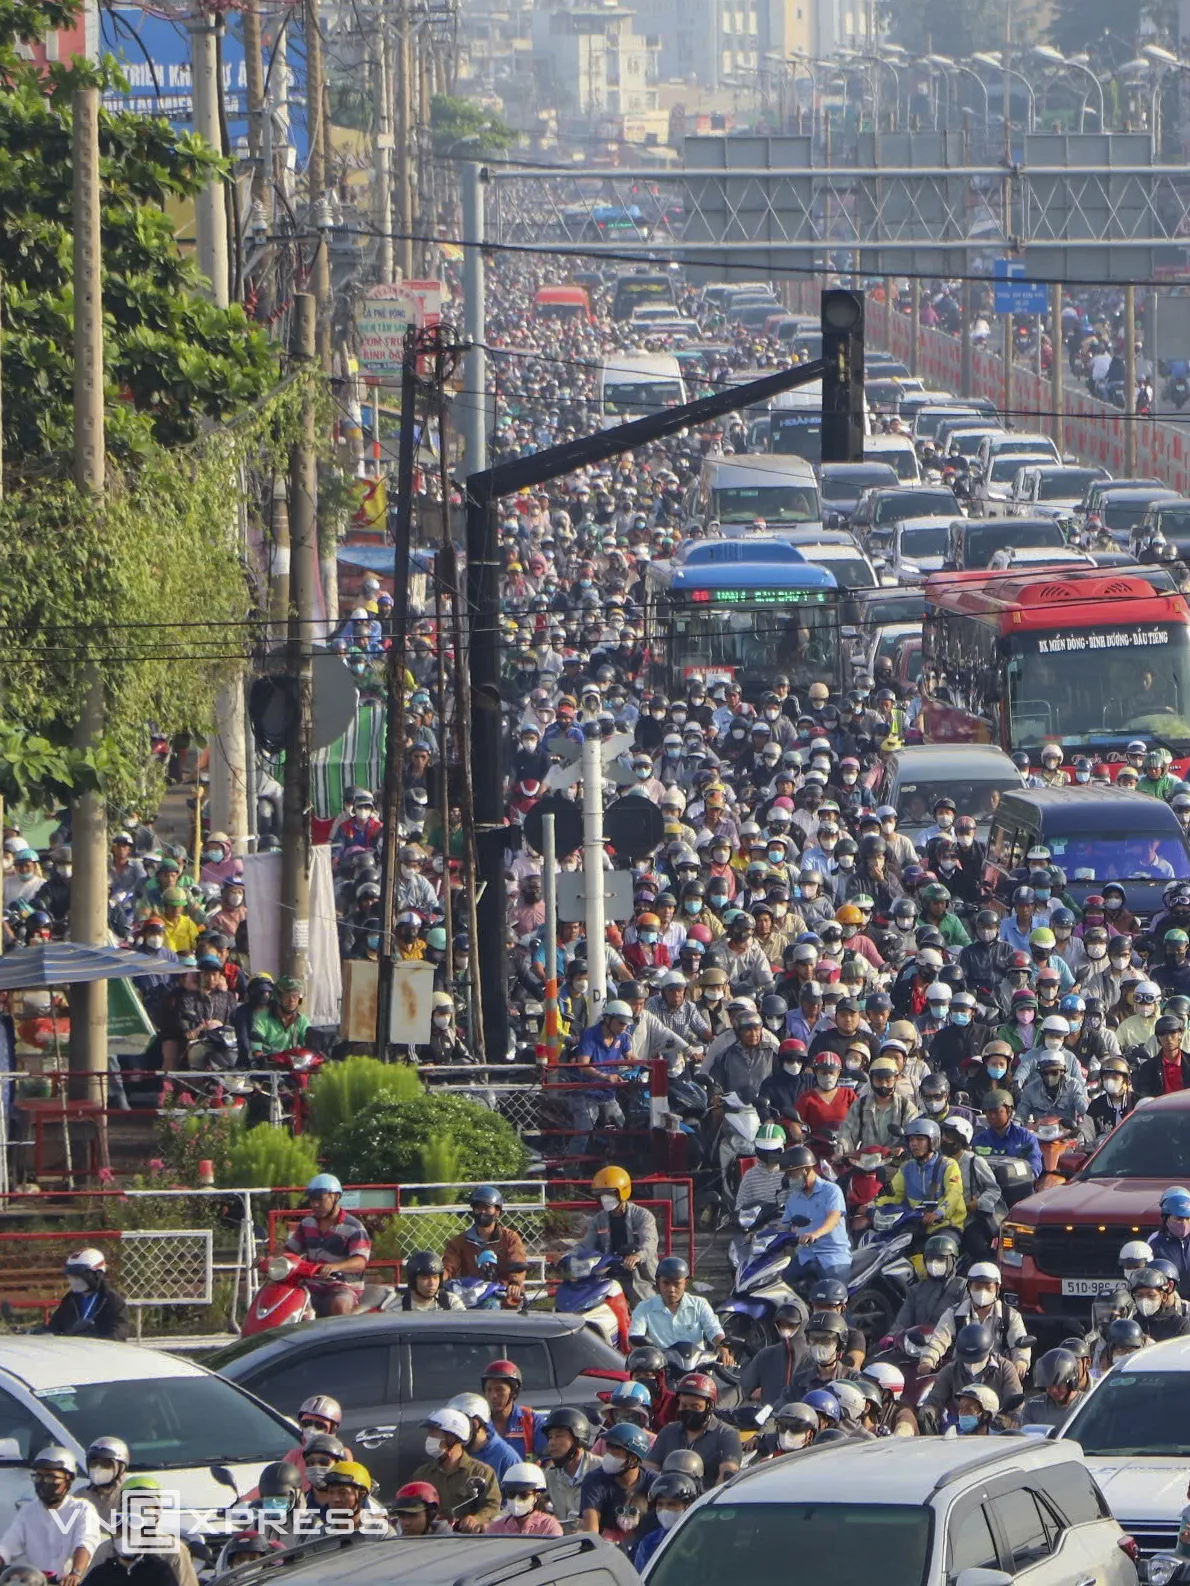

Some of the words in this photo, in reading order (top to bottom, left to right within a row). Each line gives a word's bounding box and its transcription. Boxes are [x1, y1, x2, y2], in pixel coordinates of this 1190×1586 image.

[1049, 633, 1066, 652] MIỀN
[1088, 632, 1106, 649] BÌNH
[1147, 625, 1168, 645] TIẾNG
